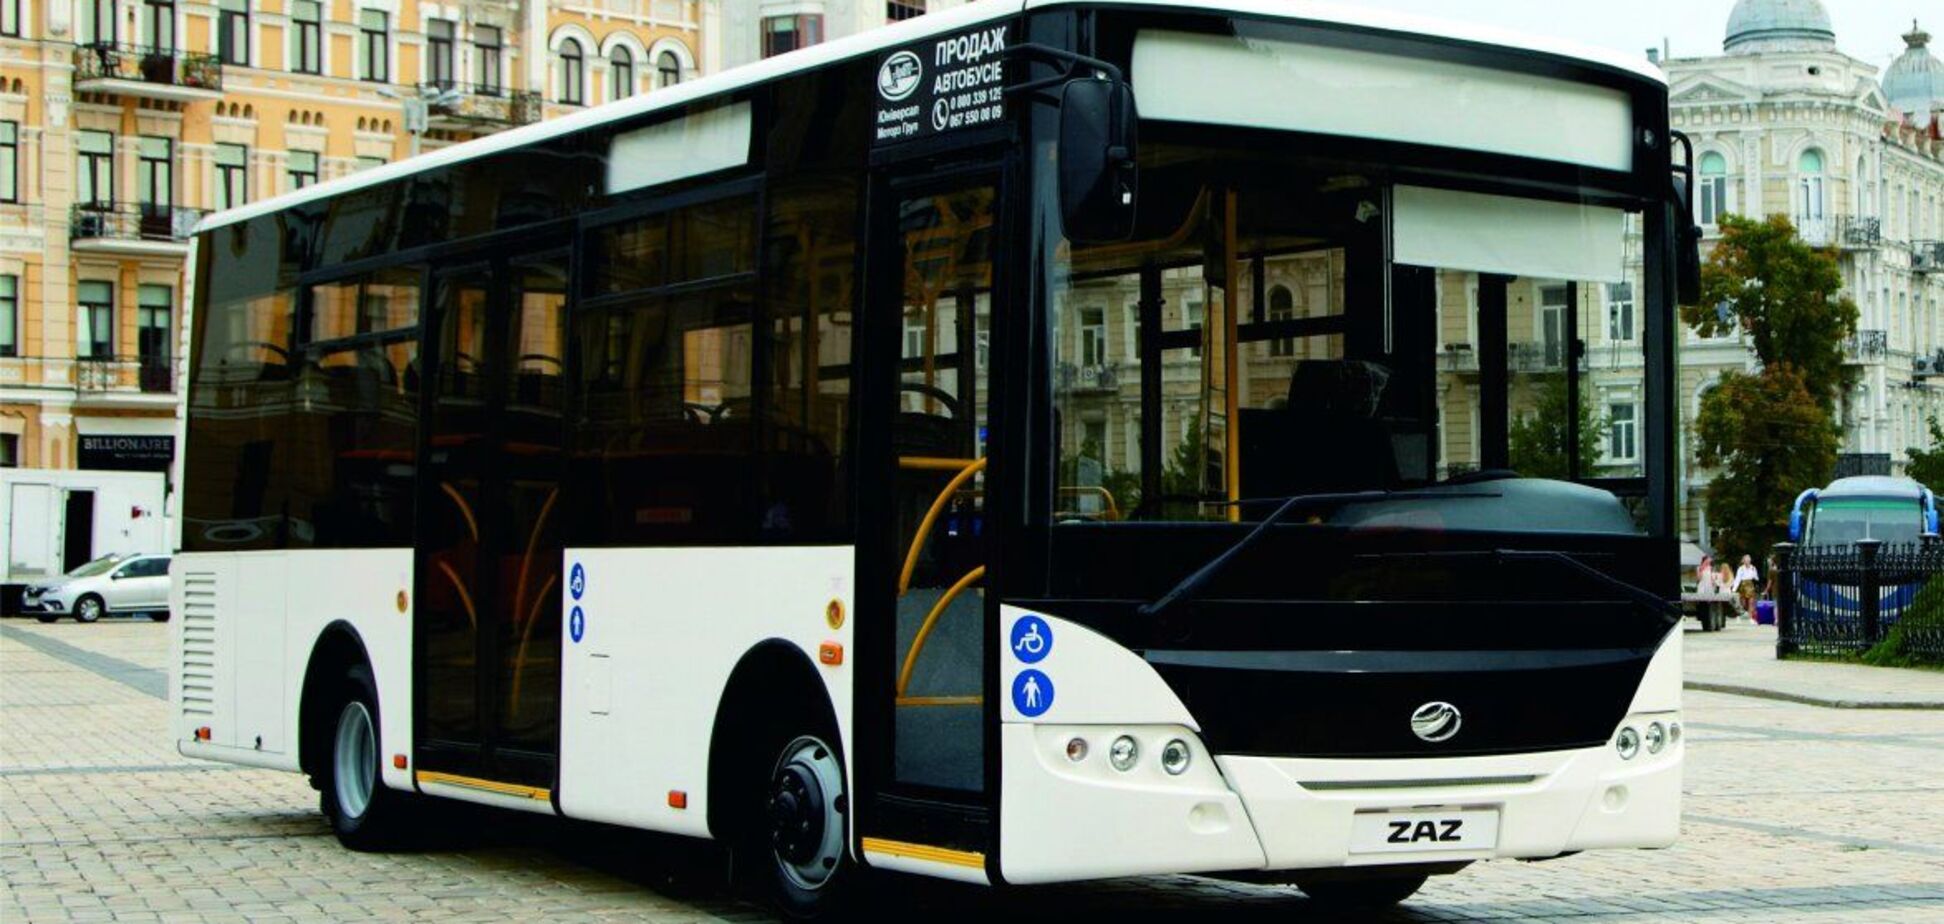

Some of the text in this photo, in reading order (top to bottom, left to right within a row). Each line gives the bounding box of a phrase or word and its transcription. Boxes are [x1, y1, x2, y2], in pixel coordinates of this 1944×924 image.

[935, 26, 1006, 66] ПРОДАЖ
[950, 96, 956, 110] 0
[949, 112, 964, 128] 067
[965, 109, 979, 124] 550
[83, 438, 171, 450] BILLIONAIRE
[1387, 819, 1463, 844] ZAZ
